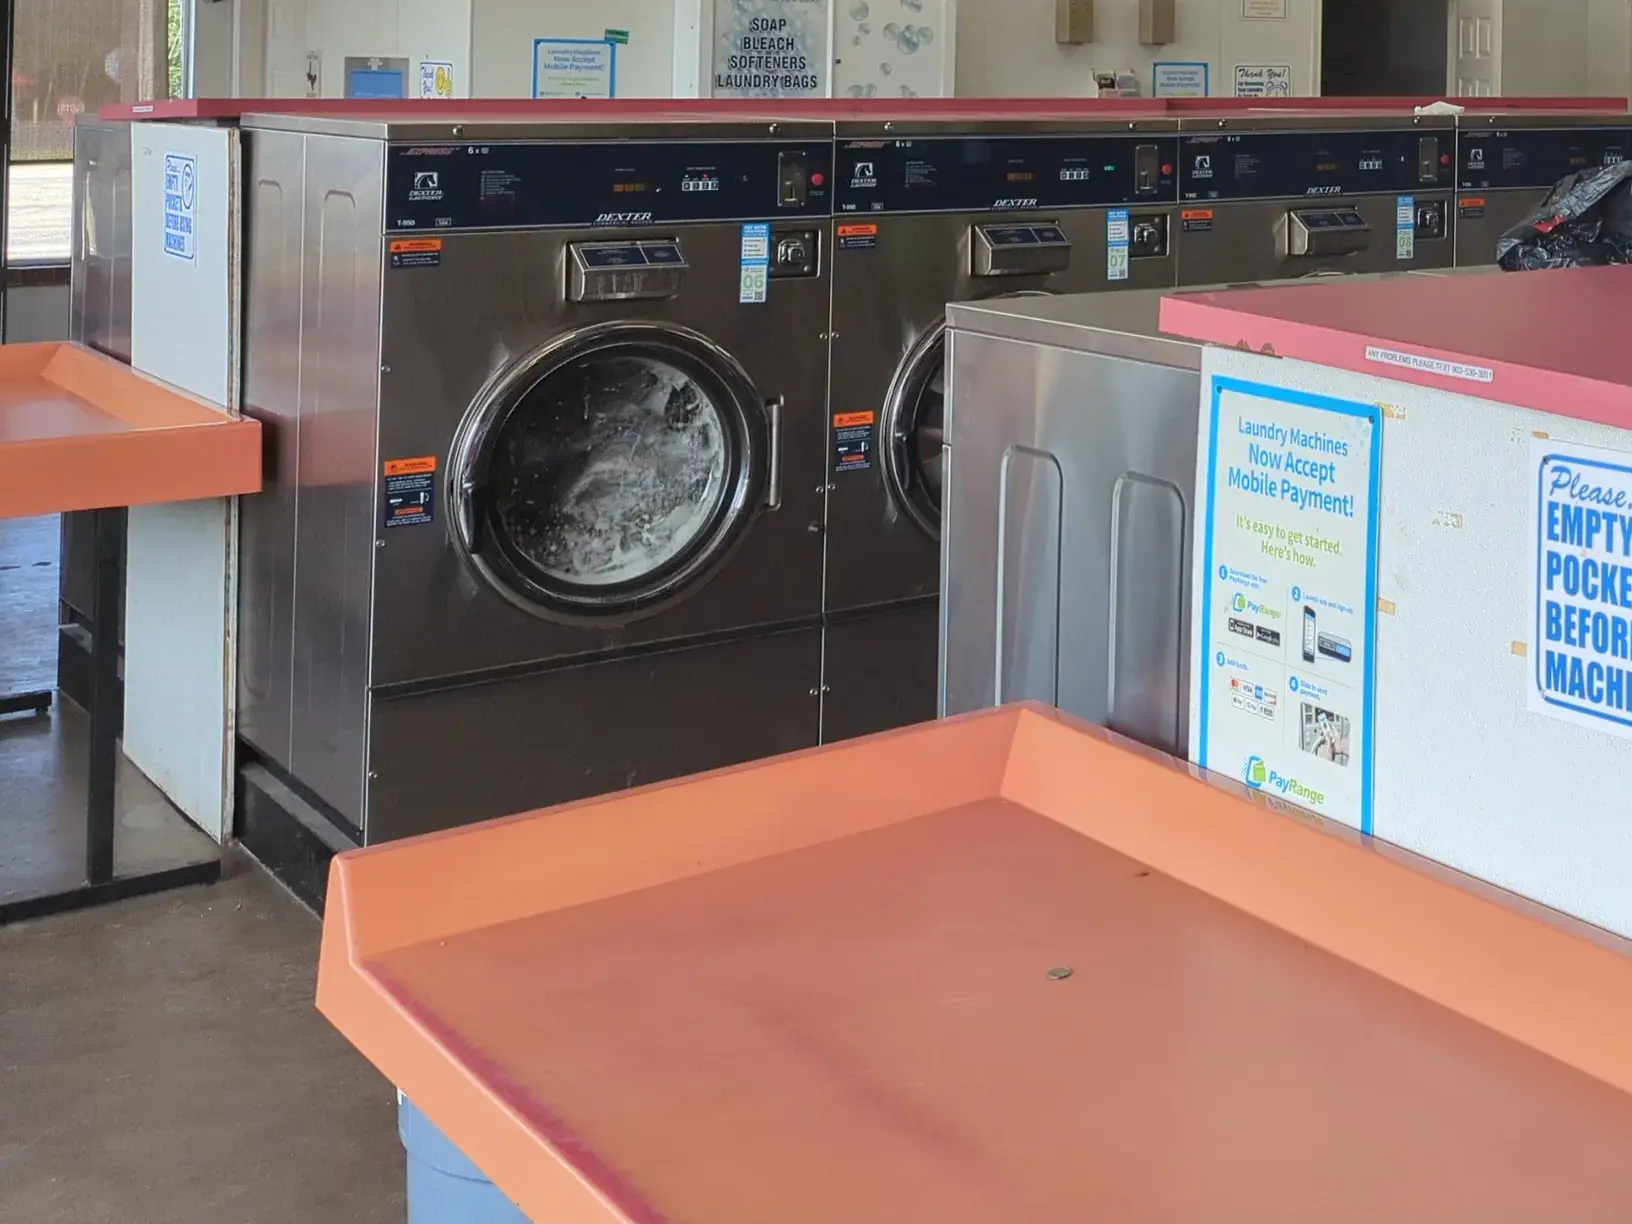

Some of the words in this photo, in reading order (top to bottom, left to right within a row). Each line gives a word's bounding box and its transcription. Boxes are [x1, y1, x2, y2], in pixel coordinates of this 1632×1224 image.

[752, 18, 787, 32] SOAP
[743, 36, 794, 51] BLEACH
[730, 55, 806, 70] SOFTENERS
[1238, 68, 1263, 78] Thank
[1266, 68, 1286, 80] You!
[717, 75, 779, 88] LAUNDRY
[783, 75, 817, 89] BAGS
[1306, 185, 1342, 194] DEXTER
[993, 197, 1039, 208] DEXTER
[597, 212, 652, 223] DEXTER
[1110, 254, 1126, 268] 07
[743, 275, 764, 289] 06
[1367, 349, 1380, 359] ANY
[1380, 351, 1411, 365] PROBLEMS
[1412, 358, 1434, 370] PLEASE
[1435, 362, 1451, 372] TEXT
[1238, 416, 1288, 447] Laundry
[1289, 429, 1348, 457] Machines
[1248, 442, 1282, 470] Now
[1285, 453, 1335, 486] Accept
[1228, 466, 1277, 498] Mobile
[1281, 479, 1354, 518] Payment!
[1236, 515, 1251, 530] It's
[1252, 522, 1274, 539] easy
[1276, 525, 1286, 539] to
[1287, 531, 1303, 547] get
[1305, 533, 1343, 556] started.
[1261, 540, 1292, 561] Here's
[1292, 550, 1316, 568] how.
[1247, 600, 1281, 619] PayRange
[1269, 769, 1325, 805] PayRange
